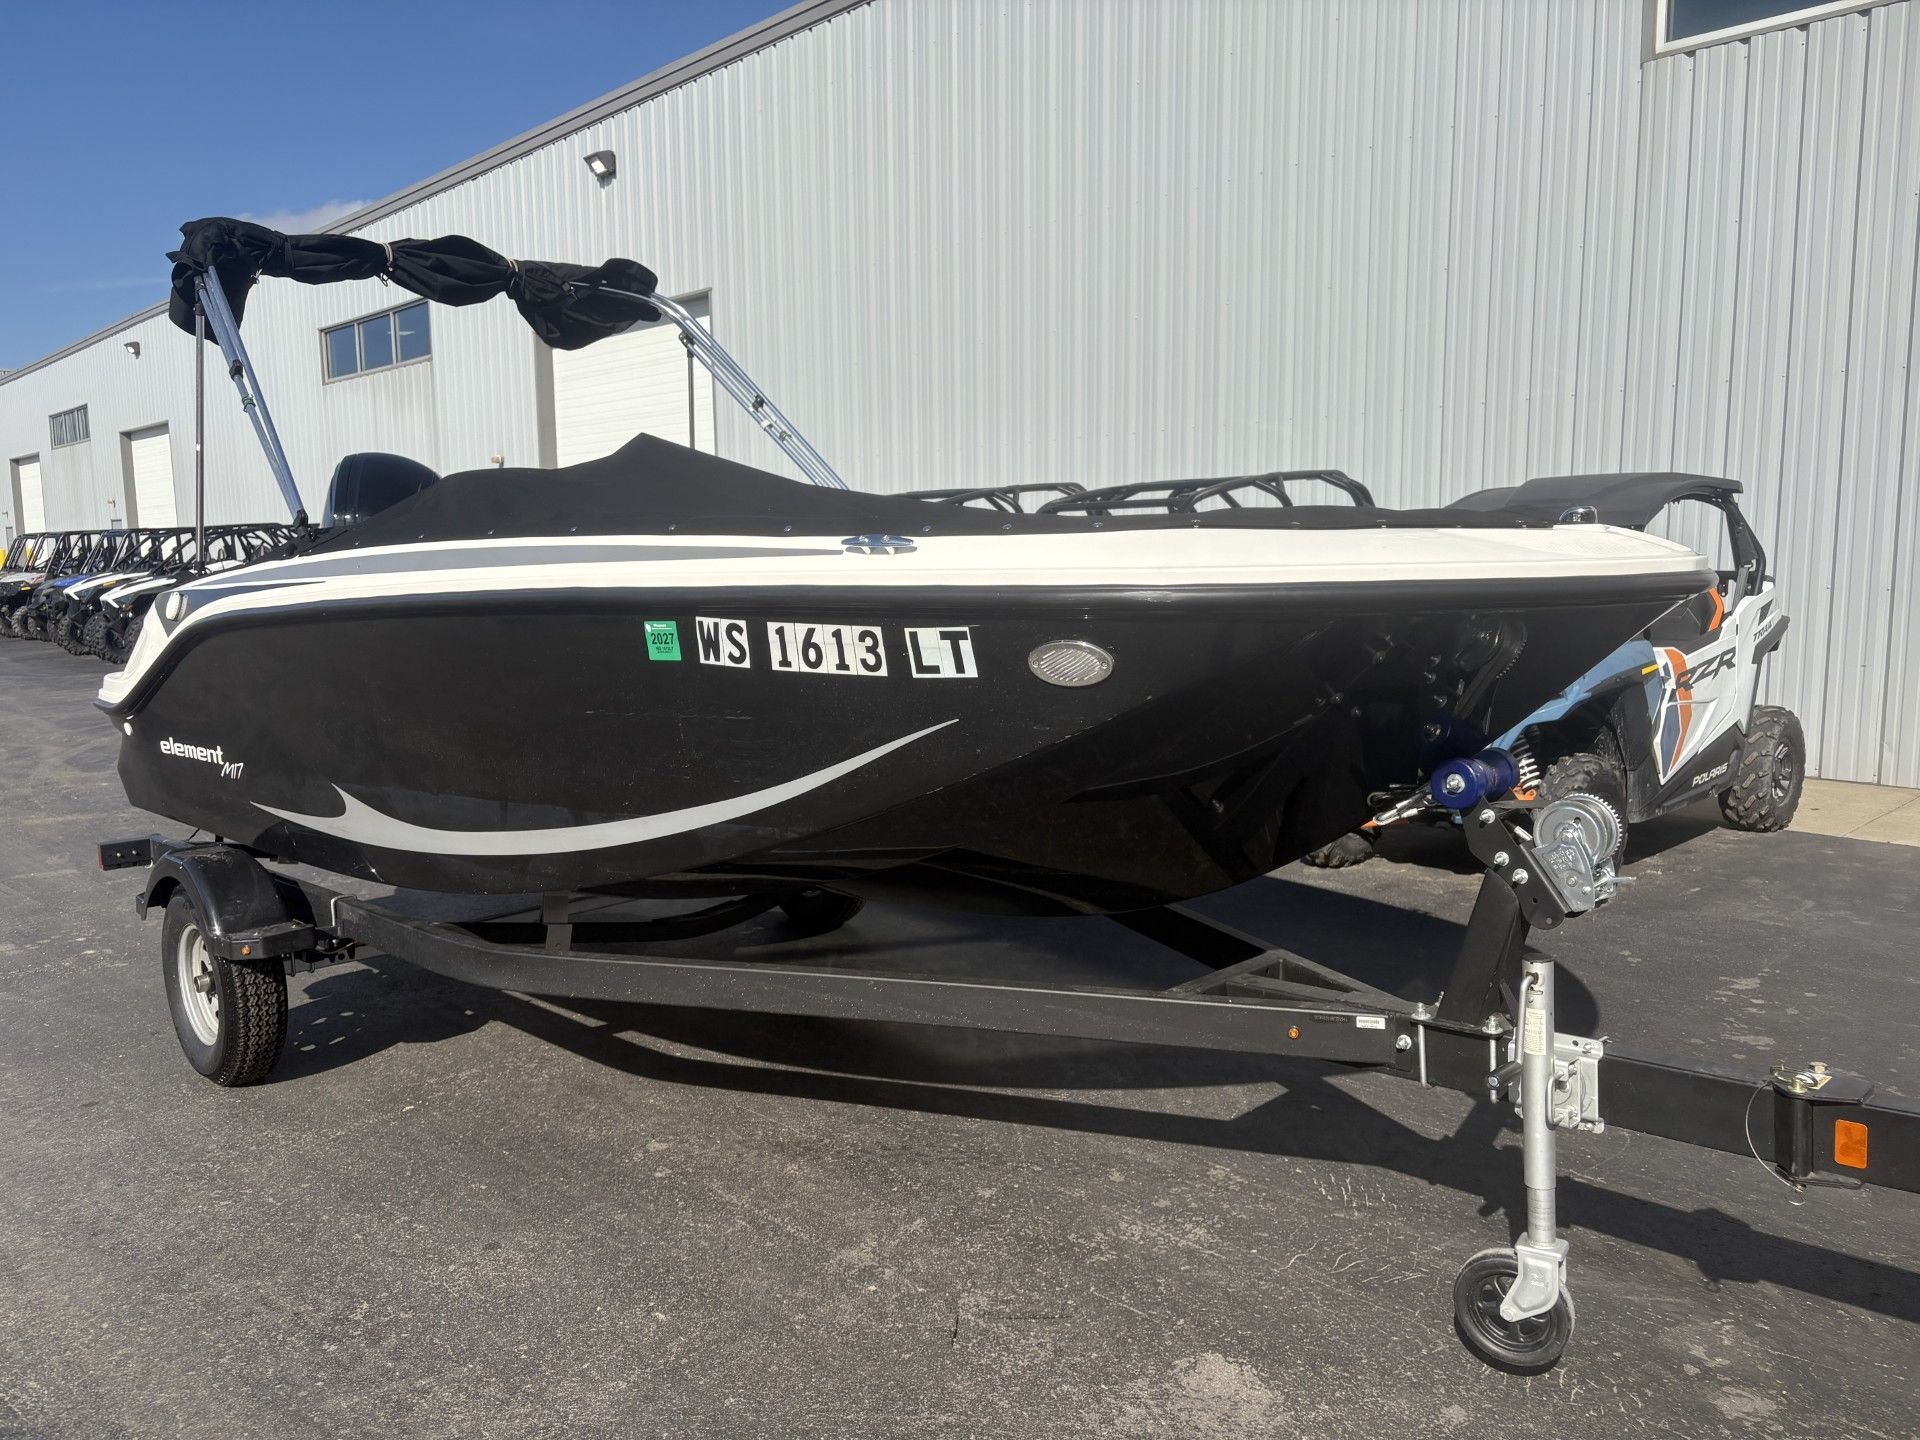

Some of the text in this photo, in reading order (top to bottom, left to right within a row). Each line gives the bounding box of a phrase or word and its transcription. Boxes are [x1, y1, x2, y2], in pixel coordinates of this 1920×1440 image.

[650, 632, 675, 645] 2027
[697, 620, 969, 675] WS 1613 LT
[160, 736, 225, 765] element
[1691, 761, 1729, 788] POLARIS
